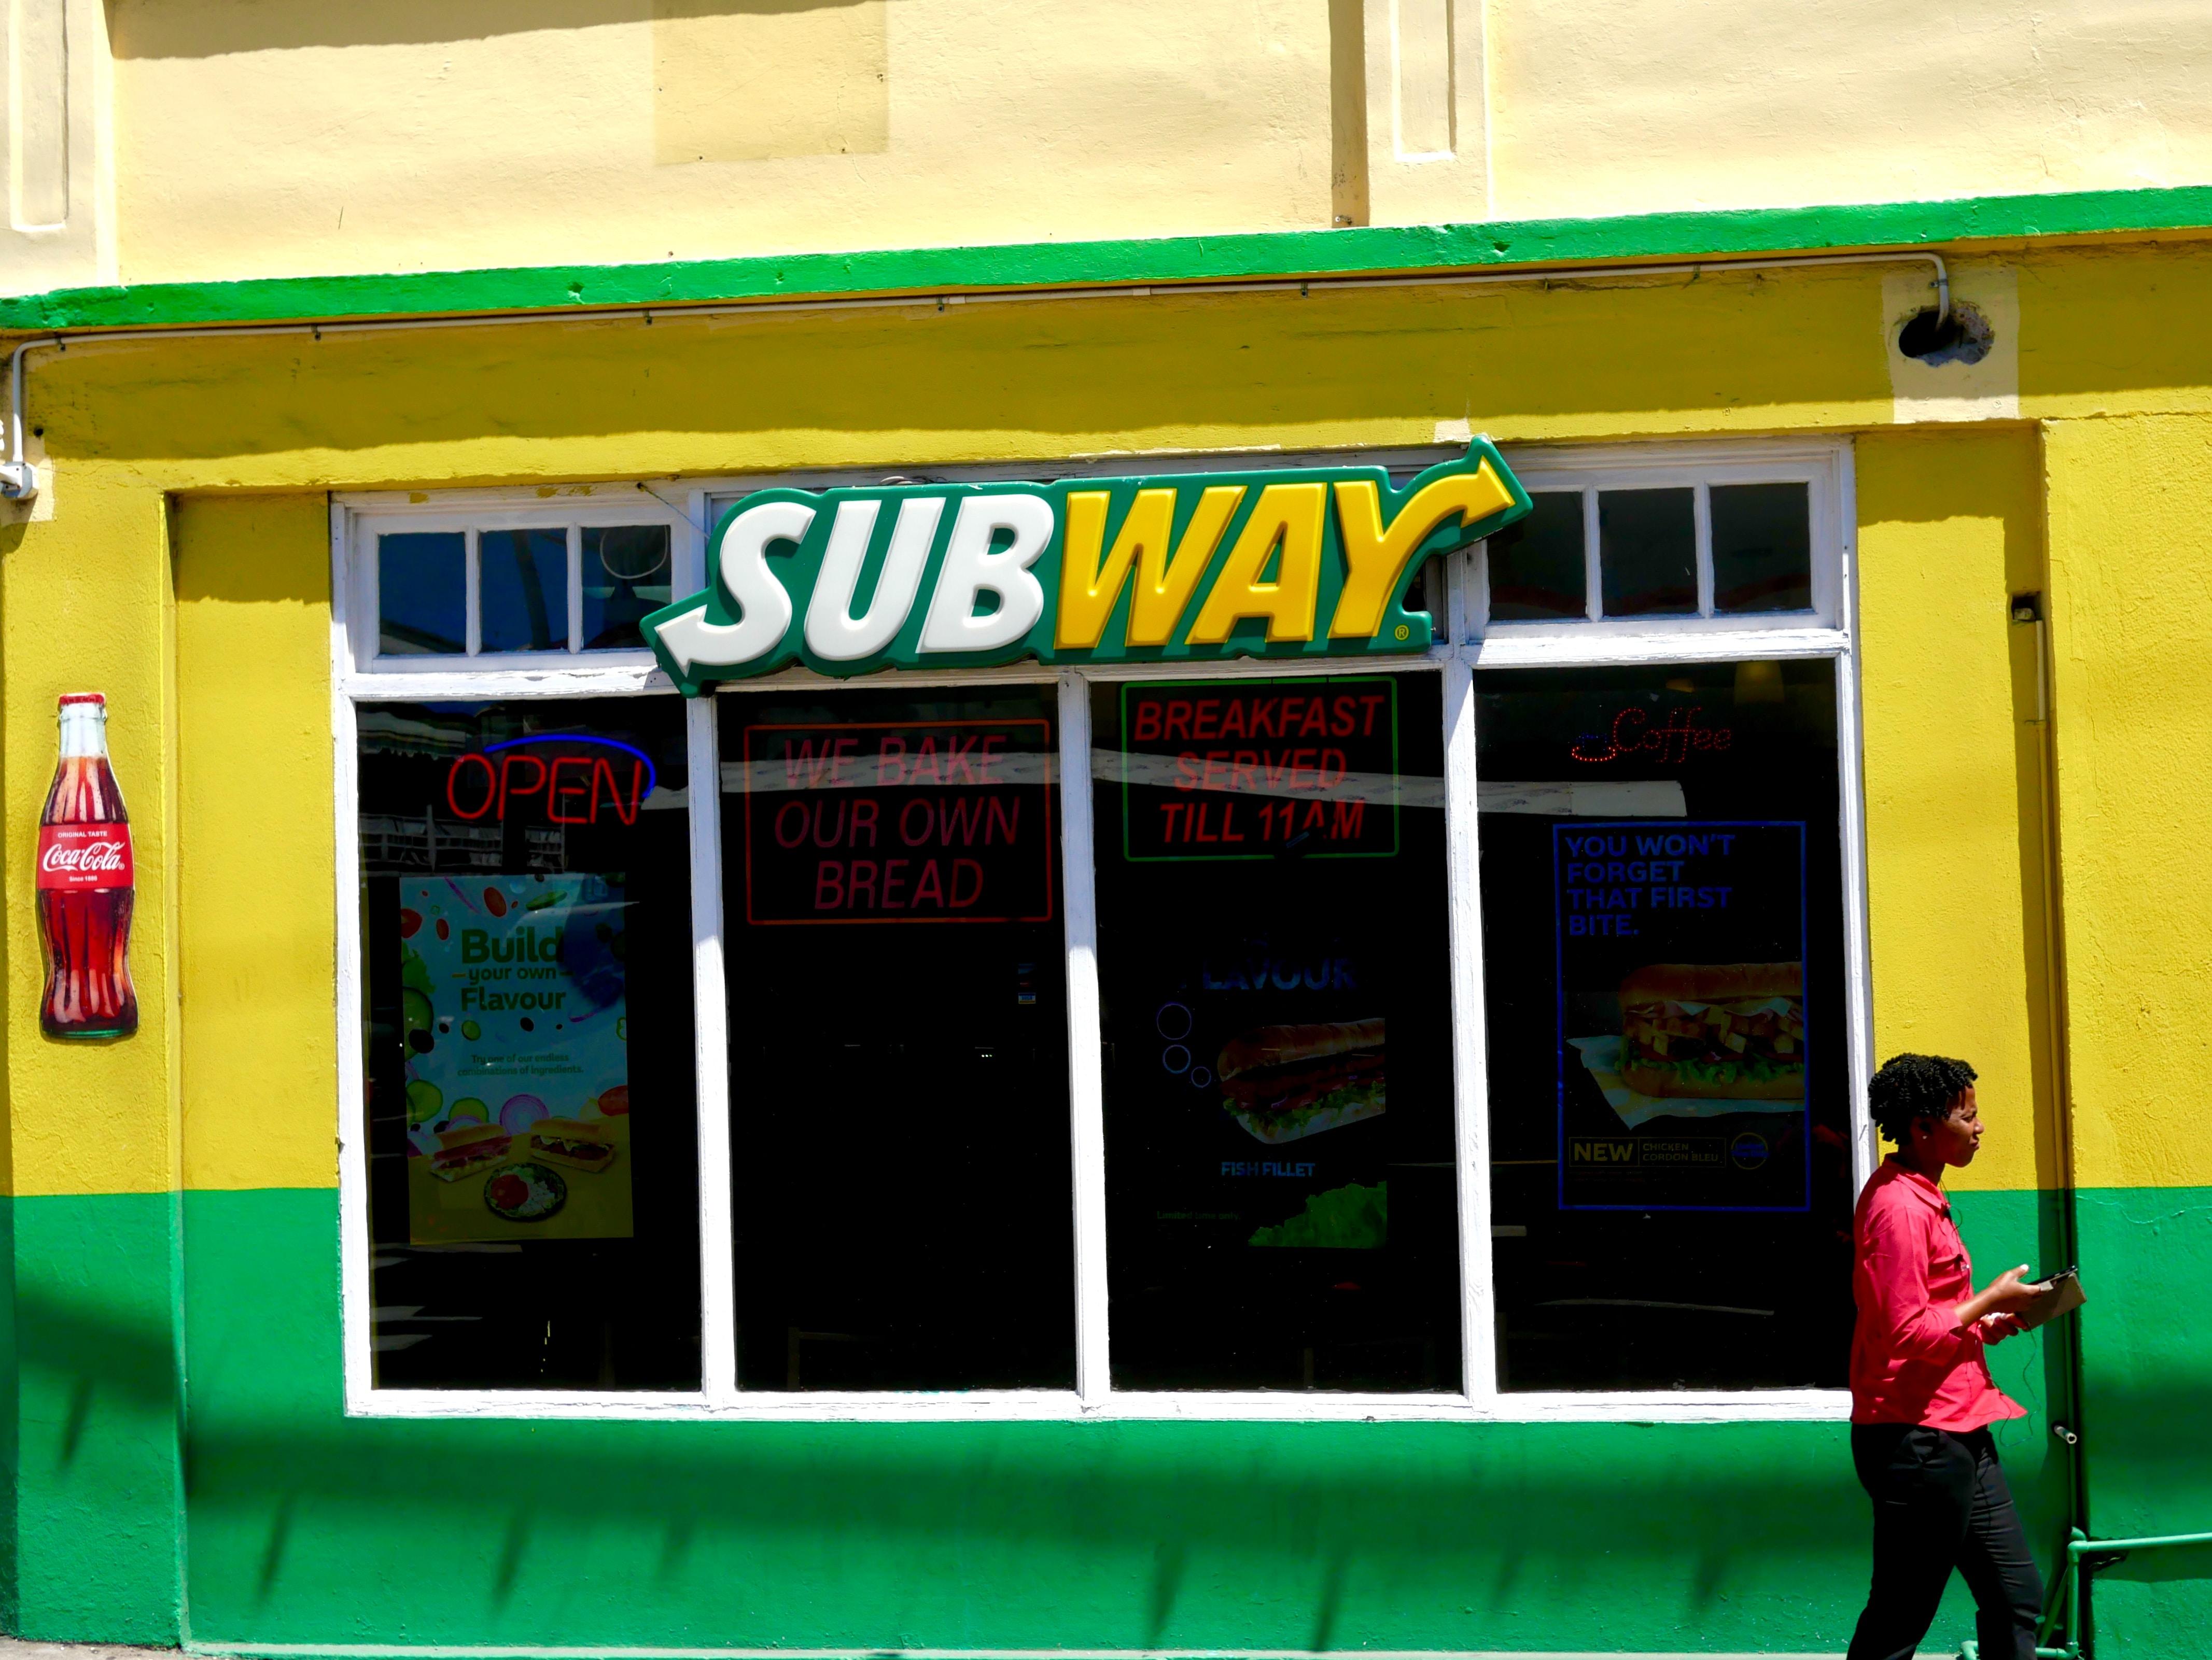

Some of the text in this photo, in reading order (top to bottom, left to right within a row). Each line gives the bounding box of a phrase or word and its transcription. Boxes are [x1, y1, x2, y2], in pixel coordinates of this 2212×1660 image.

[656, 455, 1515, 676] SUBWAY
[1133, 694, 1385, 741] BREAKFAST
[1612, 706, 1733, 763] Coffee
[785, 734, 1007, 789] WE BAKE
[1174, 747, 1348, 793] SERVED
[446, 752, 644, 826] OPEN
[775, 796, 1021, 849] OUR OWN
[1159, 801, 1245, 843] TILL
[43, 841, 125, 871] Coca-Cola
[1564, 834, 1736, 858] YOU WON'T
[814, 857, 984, 911] BREAD
[1566, 861, 1685, 884] FORGET
[1566, 886, 1733, 910] THAT FIRST
[1568, 914, 1640, 936] BITE.
[461, 926, 564, 963] Build
[469, 966, 556, 984] your own
[460, 986, 566, 1011] Flavour
[471, 1054, 486, 1064] Try
[506, 1053, 516, 1062] of
[535, 1053, 569, 1062] endless
[520, 1065, 529, 1074] of
[1574, 1142, 1689, 1162] NEW CHICKEN
[1643, 1152, 1718, 1161] CORDON BLEU
[1220, 1162, 1316, 1176] FISH FILLET
